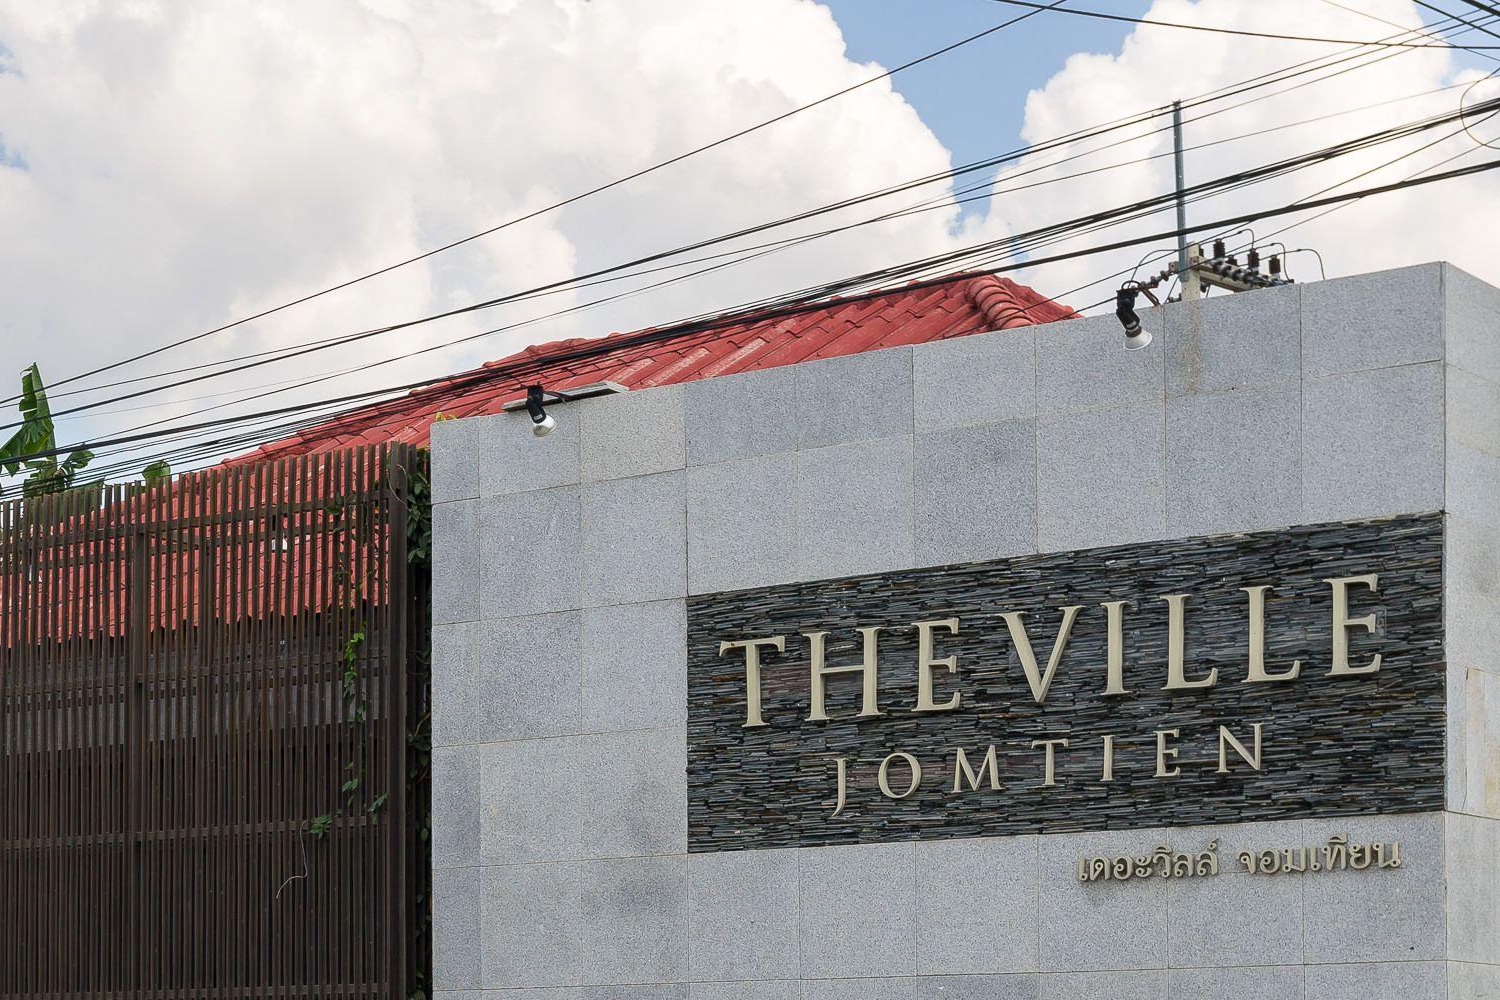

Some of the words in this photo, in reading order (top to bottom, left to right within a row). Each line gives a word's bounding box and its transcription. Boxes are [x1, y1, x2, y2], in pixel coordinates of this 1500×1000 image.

[719, 617, 962, 729] THE
[996, 573, 1383, 704] VILLE
[832, 722, 1263, 817] JOMTIEN
[1079, 838, 1219, 882] เดอะวิลล์
[1236, 832, 1402, 874] จอมเทียน
